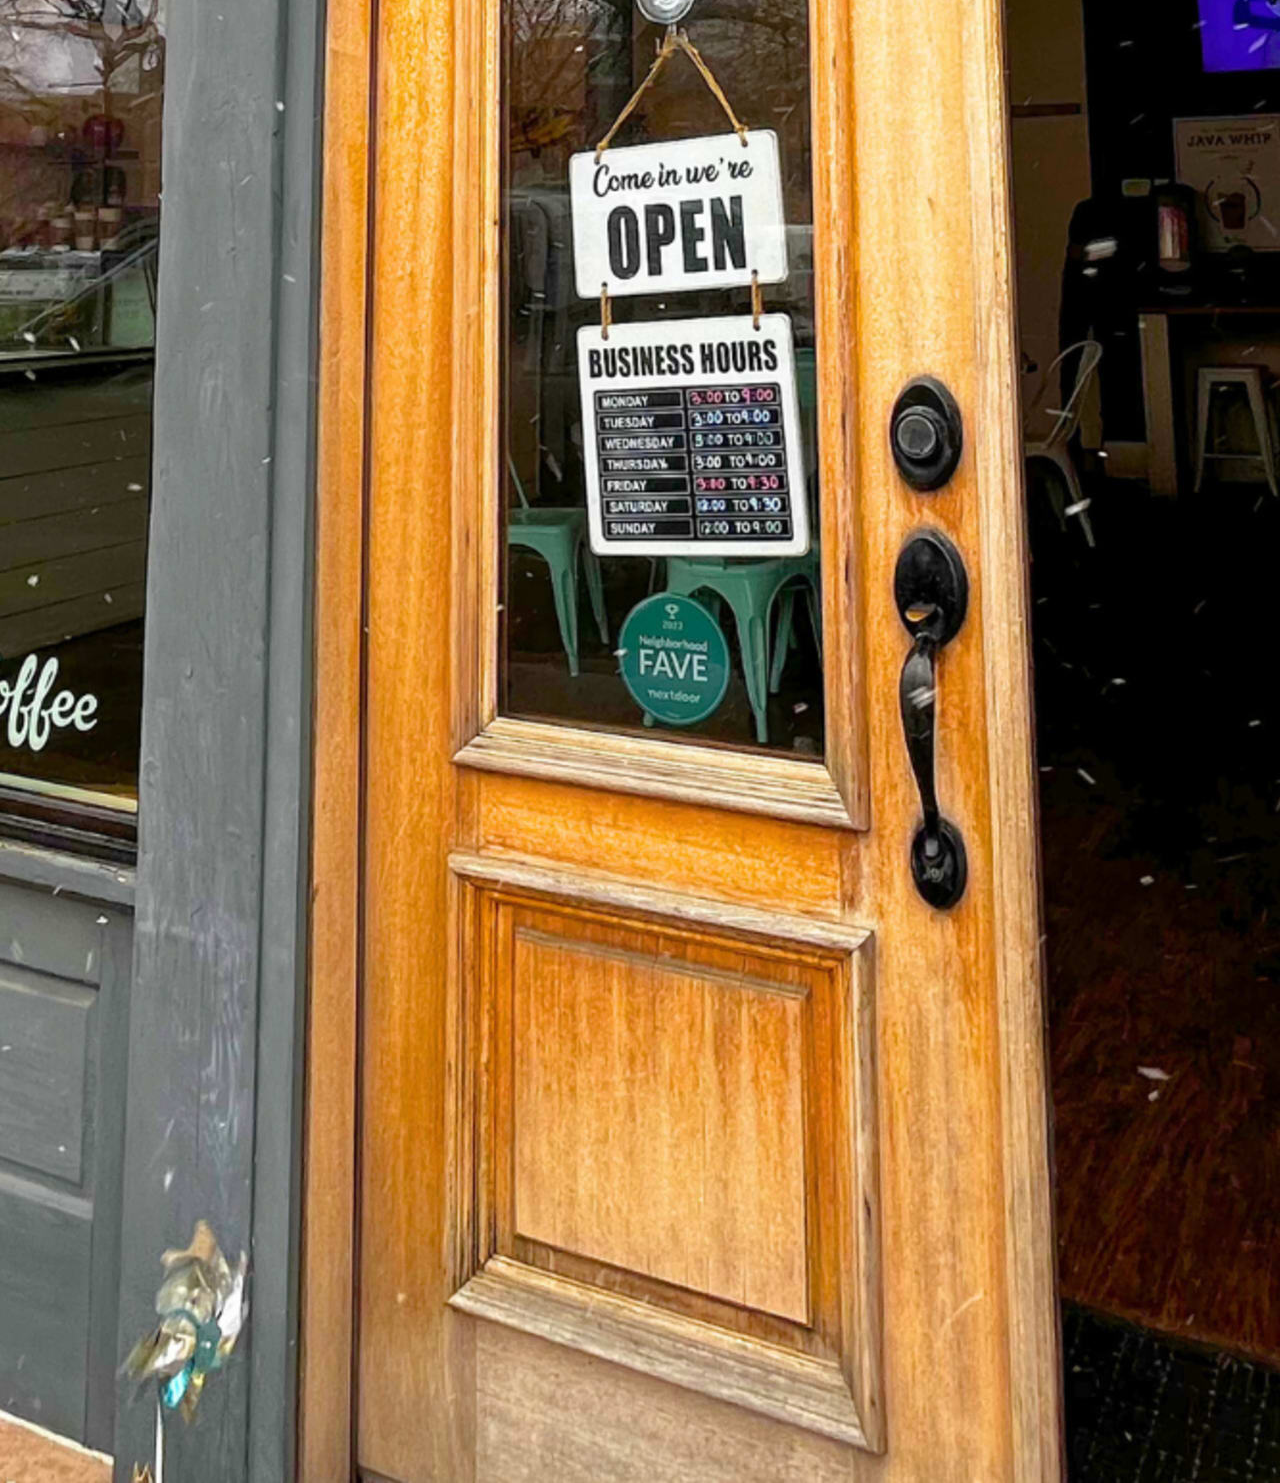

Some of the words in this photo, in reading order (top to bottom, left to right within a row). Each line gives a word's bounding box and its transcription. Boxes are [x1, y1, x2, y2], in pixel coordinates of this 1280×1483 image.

[1186, 133, 1226, 148] JAVA
[1228, 132, 1272, 146] WHIP
[593, 163, 654, 198] Come
[658, 163, 683, 187] in
[685, 157, 754, 186] we're
[606, 194, 747, 280] OPEN
[588, 343, 695, 379] BUSINESS
[699, 339, 778, 375] HOURS
[601, 395, 649, 409] MONDAY
[724, 390, 740, 403] TO
[603, 415, 655, 429] TUESDAY
[725, 412, 740, 424] TO
[604, 435, 675, 450] WEDNESDAY
[727, 434, 743, 445] TO
[606, 457, 668, 471] THURSDAY
[729, 455, 745, 468] TO
[606, 480, 648, 492] FRIDAY
[730, 478, 747, 489] TO
[609, 500, 669, 513] SATURDAY
[732, 499, 749, 511] TO
[609, 521, 656, 534] SUNDAY
[734, 521, 751, 533] TO
[639, 635, 708, 653] Neighborhood
[639, 648, 708, 682] FAVE
[647, 689, 701, 704] nextdoor
